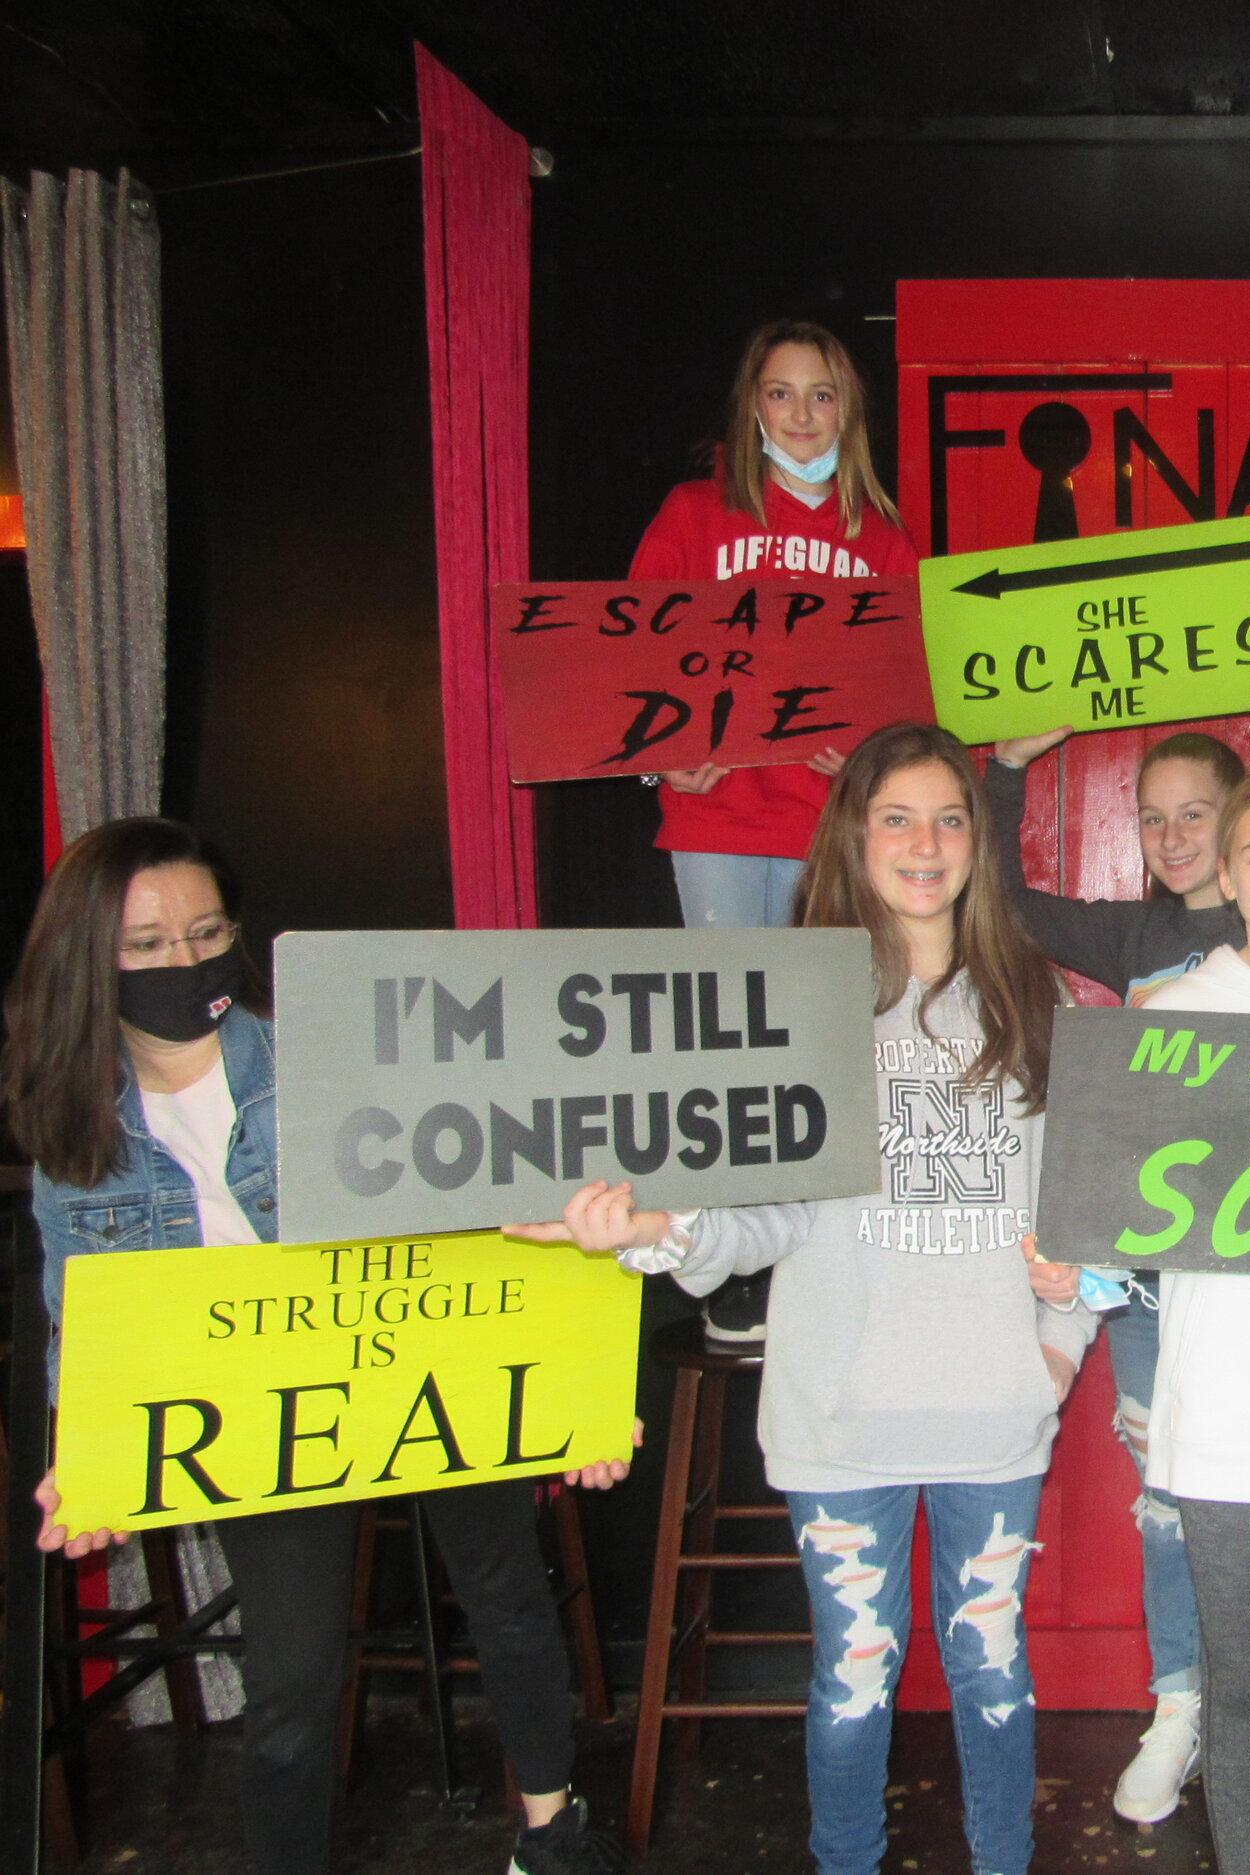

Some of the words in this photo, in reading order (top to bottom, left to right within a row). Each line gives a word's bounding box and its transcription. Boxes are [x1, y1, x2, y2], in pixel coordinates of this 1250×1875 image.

[717, 535, 879, 580] LIFEGUAR
[508, 587, 904, 638] ESCAPE
[1077, 596, 1148, 633] SHE
[679, 650, 757, 678] OR
[584, 685, 854, 771] DIE
[1090, 686, 1147, 722] ME
[374, 975, 505, 1065] I'M
[557, 970, 790, 1058] STILL
[1129, 1028, 1236, 1088] My
[333, 1083, 828, 1198] CONFUSED
[878, 1120, 1022, 1159] Northside
[857, 1206, 1033, 1256] ATHLETICS
[320, 1242, 435, 1286] THE
[207, 1278, 526, 1341] STRUGGLE
[352, 1330, 397, 1371] IS
[127, 1361, 575, 1517] REAL
